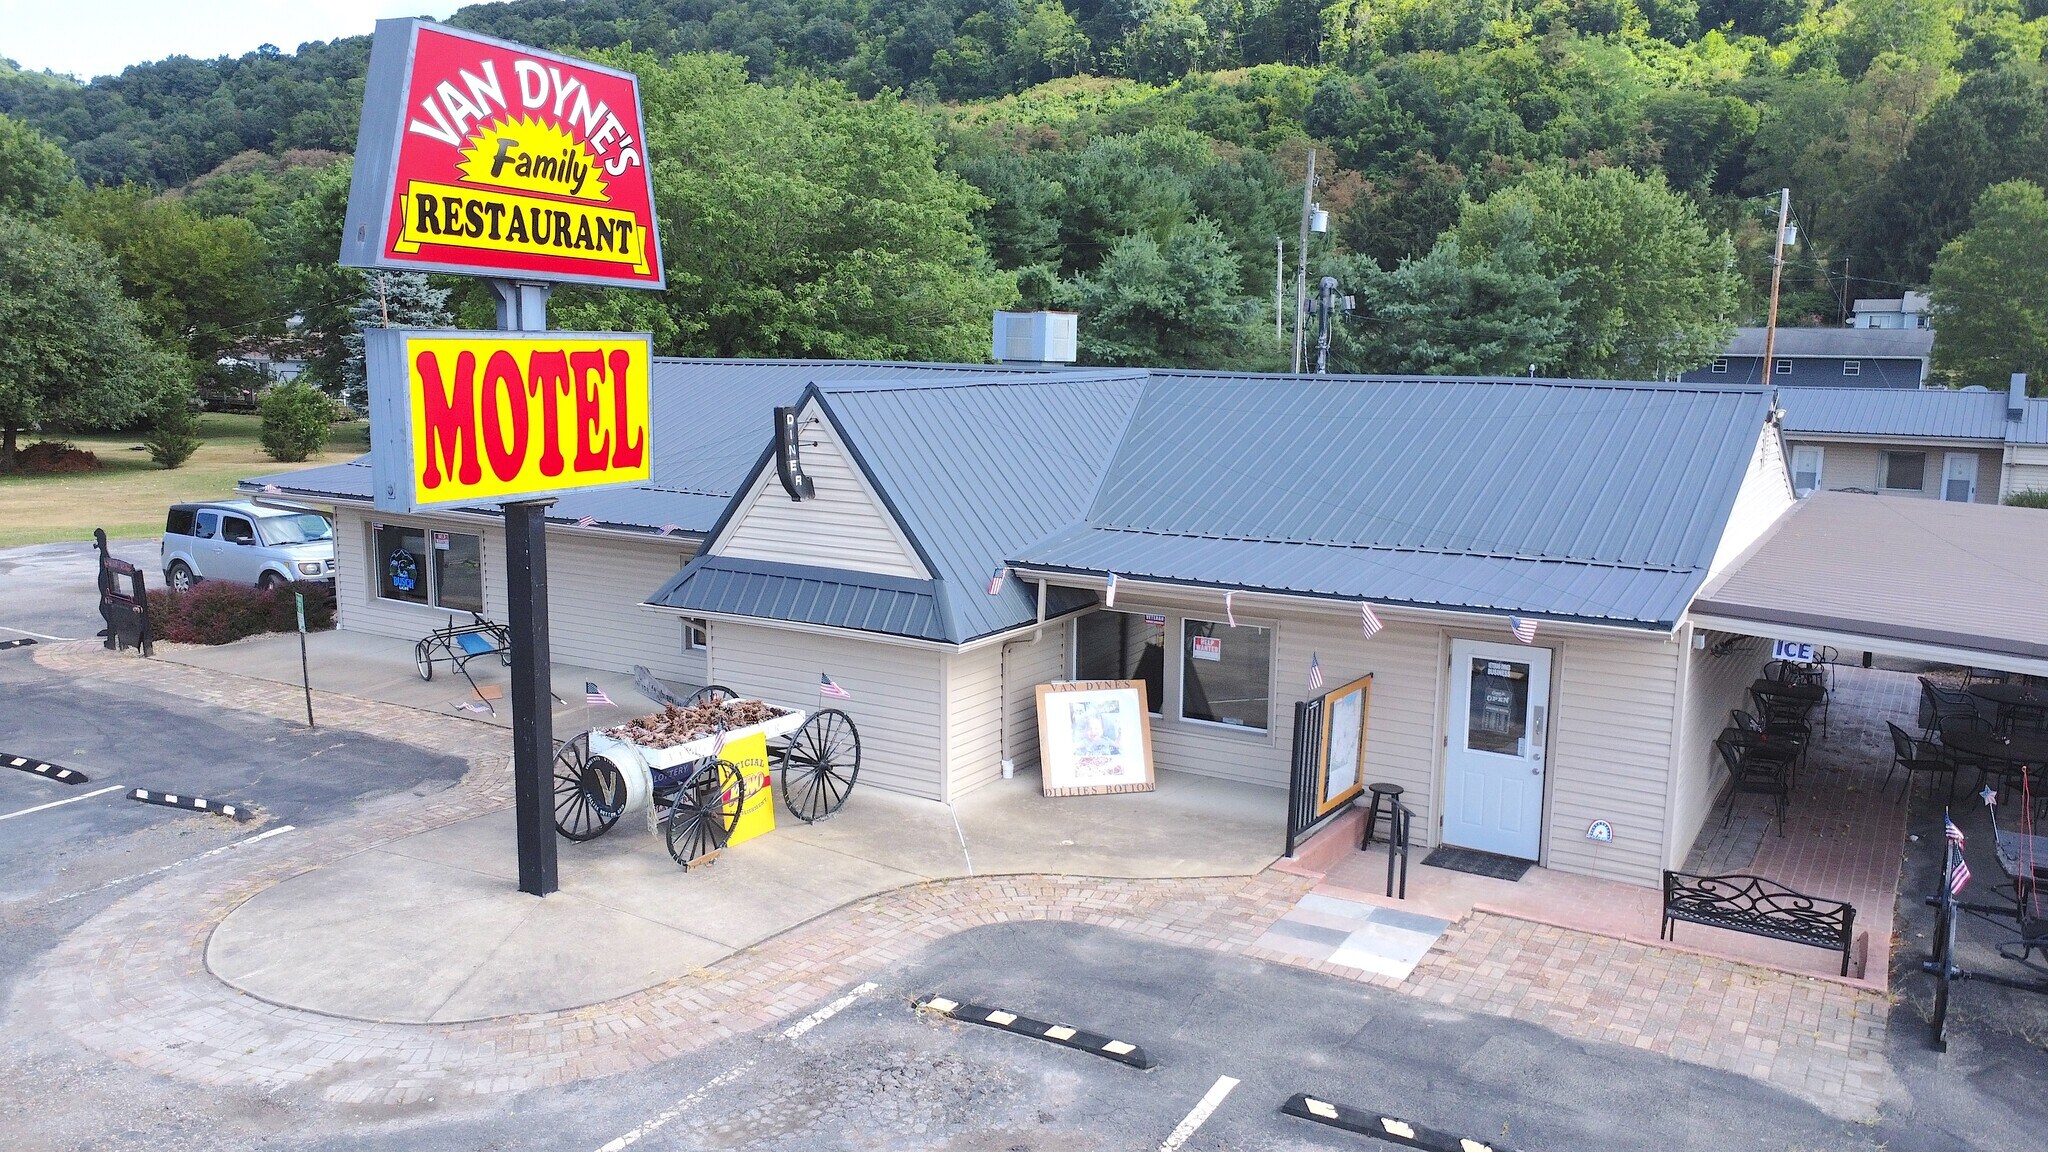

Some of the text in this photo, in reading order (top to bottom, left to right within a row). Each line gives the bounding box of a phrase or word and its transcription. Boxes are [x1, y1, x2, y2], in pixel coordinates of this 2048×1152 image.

[408, 59, 641, 177] VAN DYNE'S
[491, 138, 588, 195] Family
[415, 193, 633, 254] RESTAURANT
[416, 348, 644, 489] MOTEL
[786, 414, 802, 486] DINER
[393, 576, 415, 589] BUSCH
[1196, 644, 1219, 653] WANTED
[1200, 638, 1214, 646] HELP
[1776, 640, 1811, 659] ICE
[1051, 682, 1077, 692] VAN
[1487, 695, 1510, 704] OPEN
[594, 768, 617, 806] V
[1045, 782, 1155, 797] DILLIES BOTTOM
